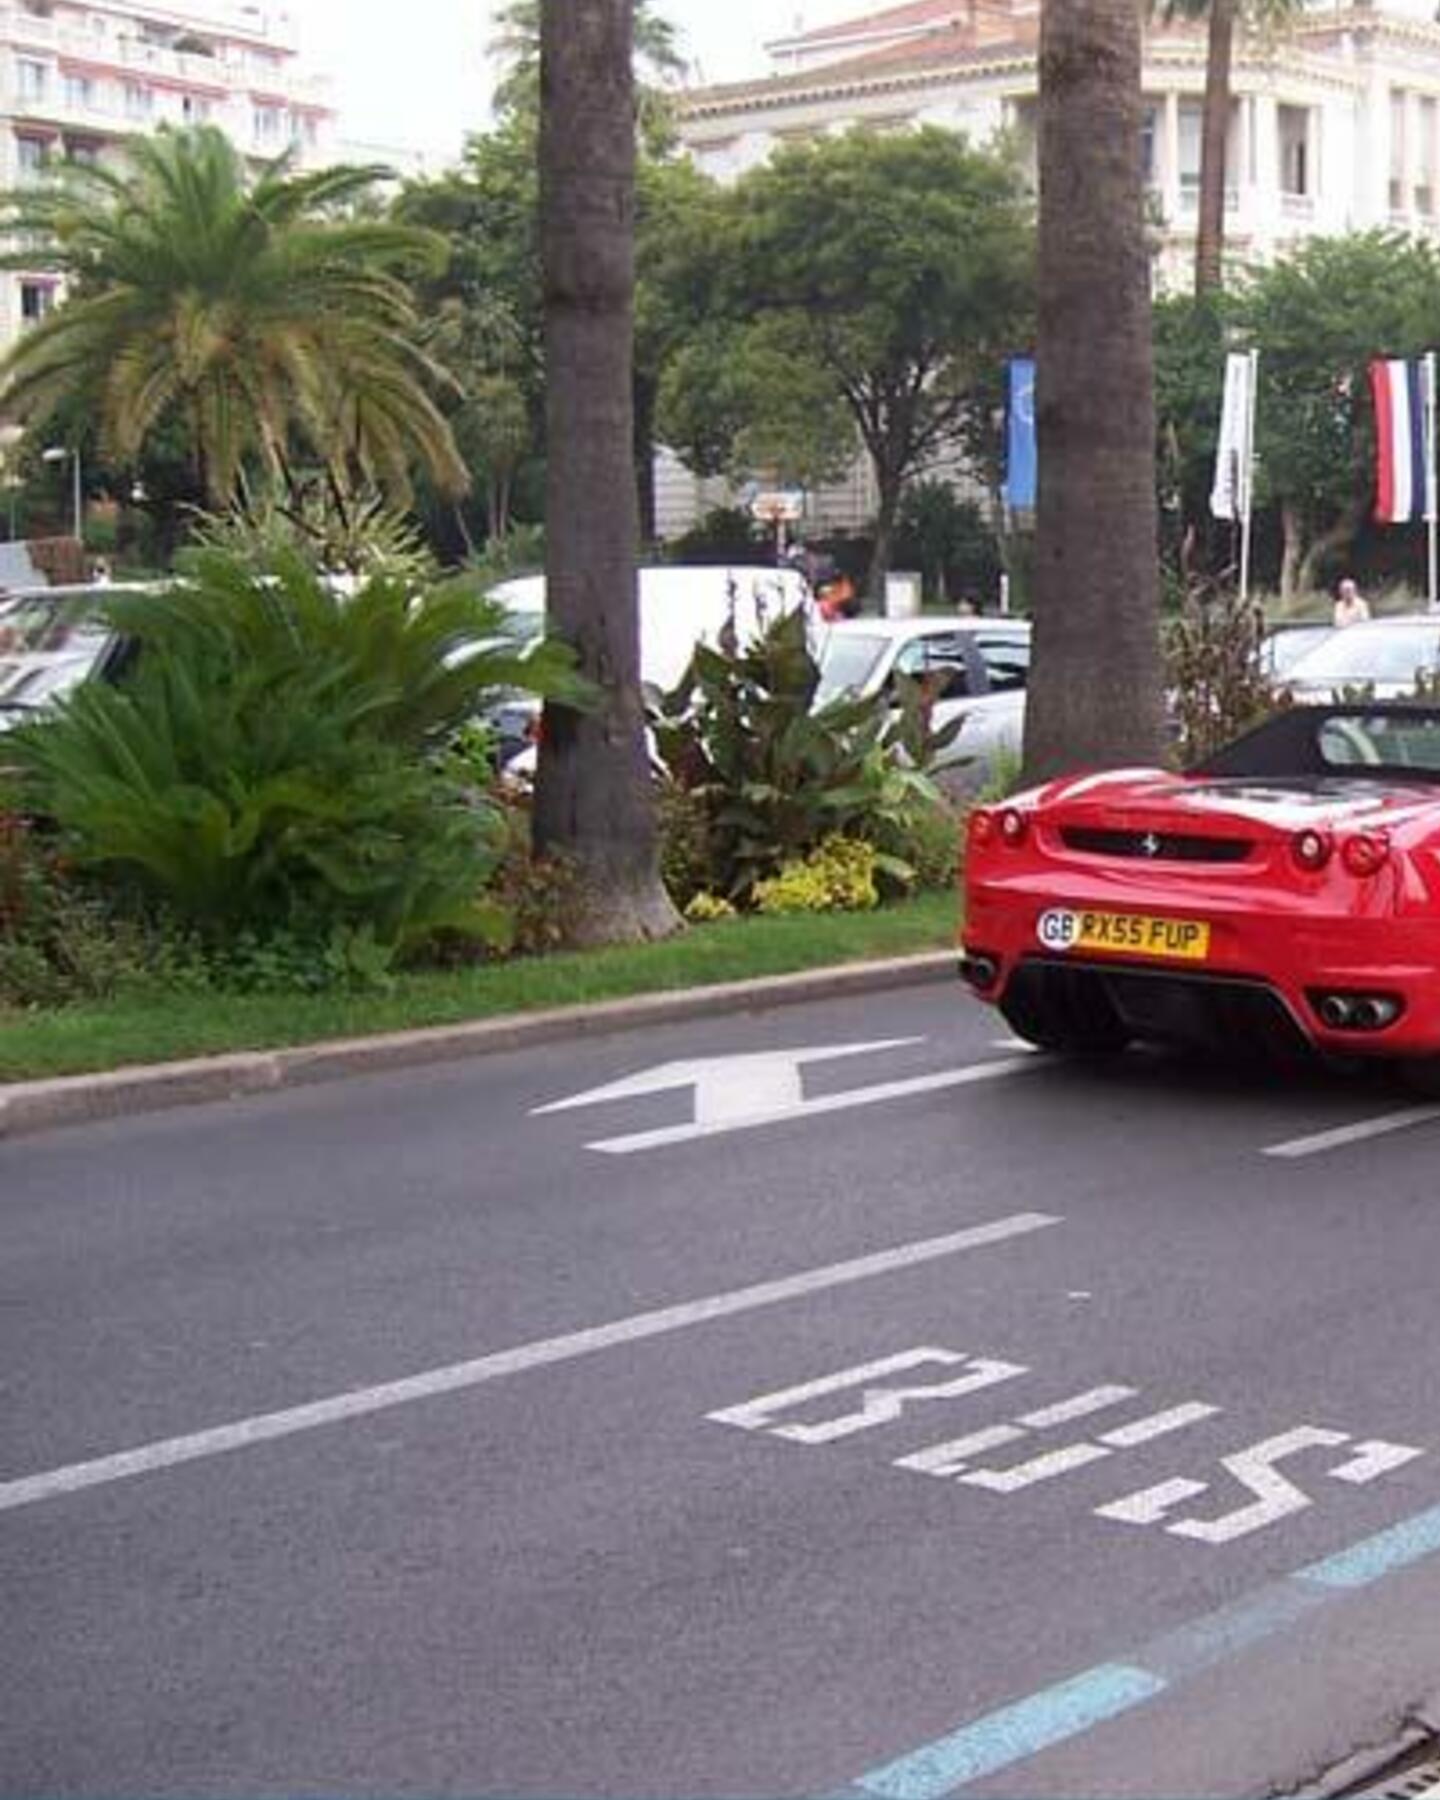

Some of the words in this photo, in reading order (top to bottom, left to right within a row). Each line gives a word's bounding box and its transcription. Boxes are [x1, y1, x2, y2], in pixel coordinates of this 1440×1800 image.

[1043, 914, 1074, 942] GB
[1079, 914, 1144, 945] RX55
[1148, 920, 1200, 951] FUP
[702, 1346, 1425, 1544] BUS
